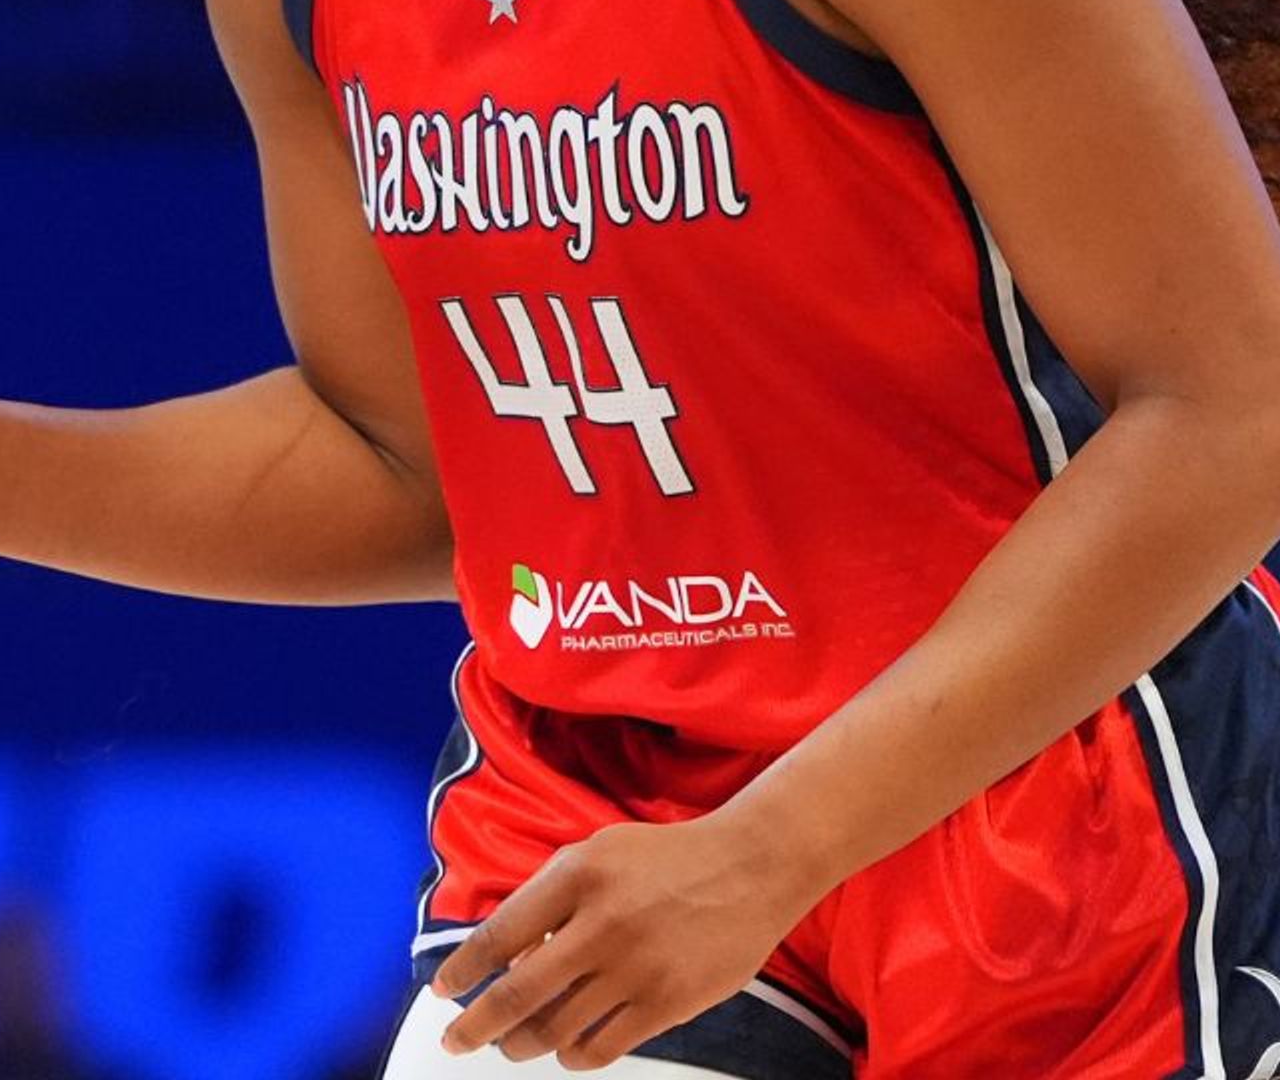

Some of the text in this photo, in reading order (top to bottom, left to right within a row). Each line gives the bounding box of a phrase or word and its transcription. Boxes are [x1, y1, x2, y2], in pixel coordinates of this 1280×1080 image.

[440, 284, 695, 496] 44
[556, 571, 787, 628] VANDA
[561, 623, 757, 652] PHARMACEUTICALS
